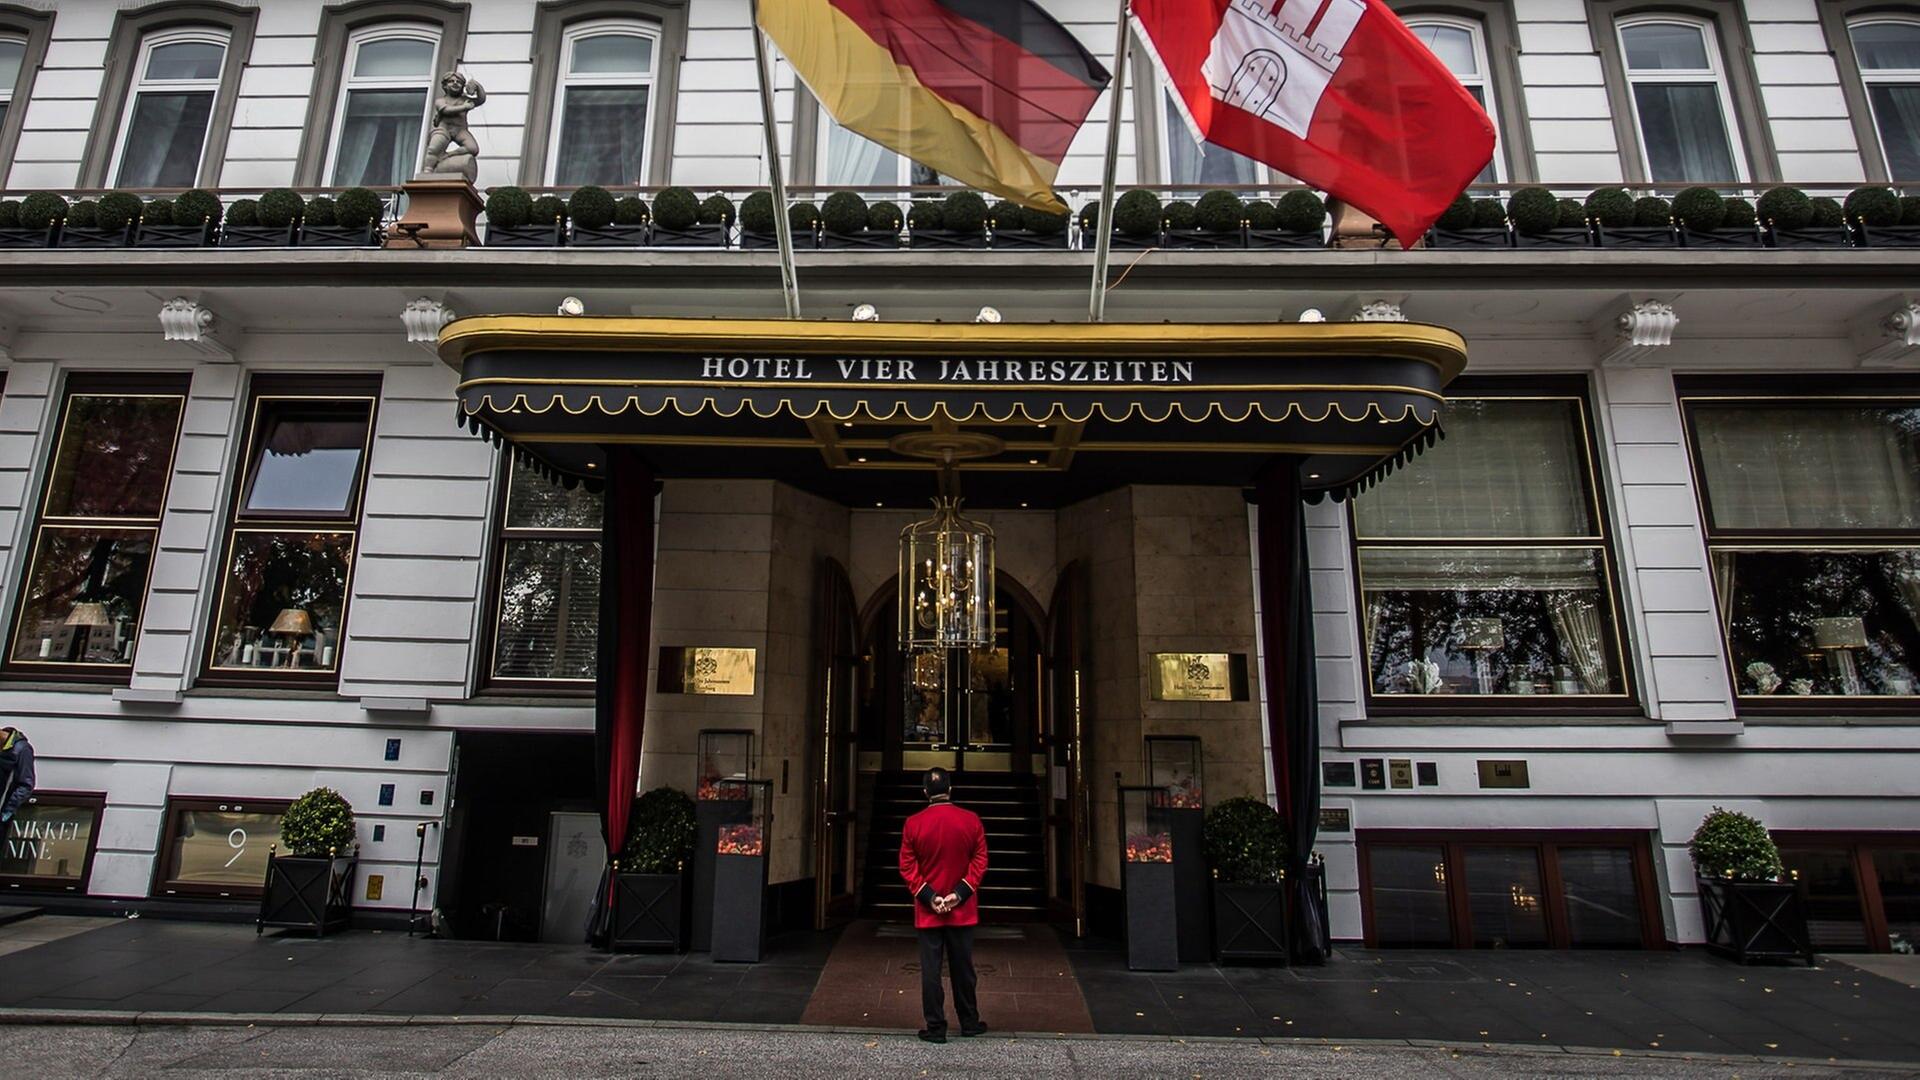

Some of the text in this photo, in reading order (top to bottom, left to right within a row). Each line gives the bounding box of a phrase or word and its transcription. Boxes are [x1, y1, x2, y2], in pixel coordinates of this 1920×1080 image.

[701, 357, 1193, 382] HOTEL VIER JAHRESZEITEN
[9, 820, 79, 840] NIKKEI
[4, 840, 55, 860] NINE
[224, 828, 246, 868] 9
